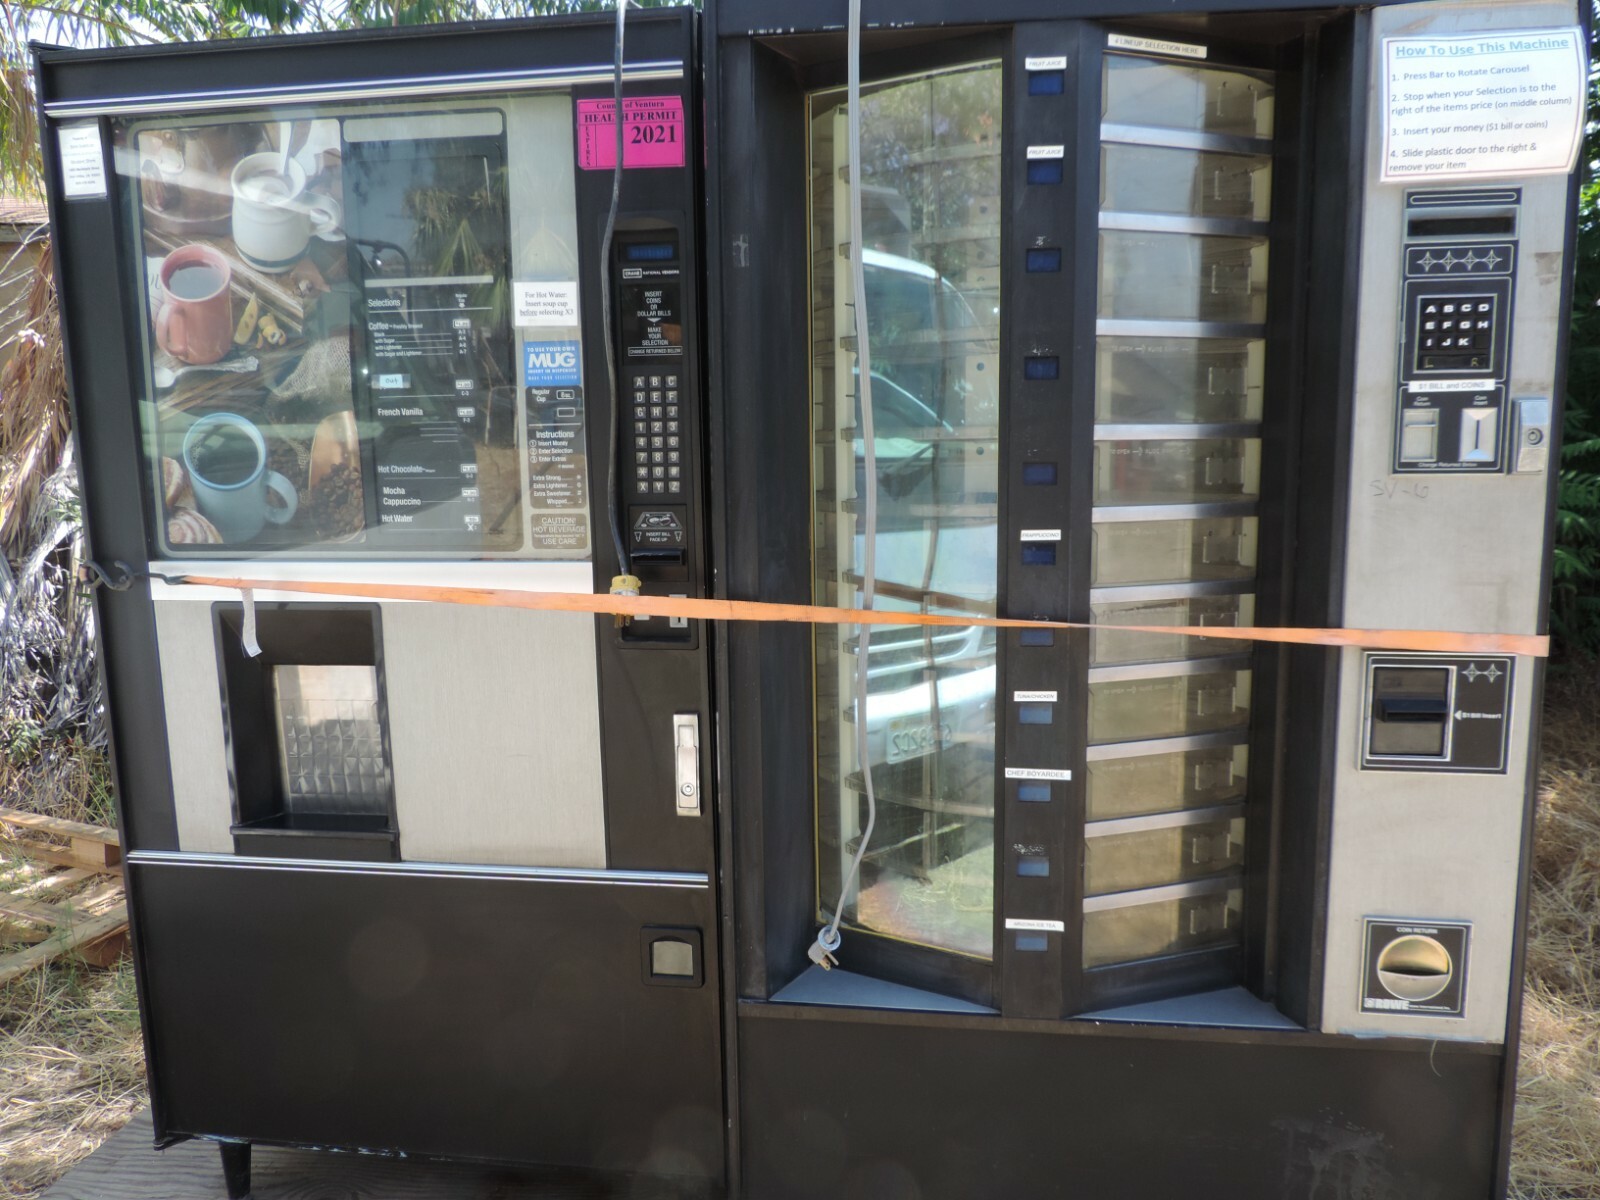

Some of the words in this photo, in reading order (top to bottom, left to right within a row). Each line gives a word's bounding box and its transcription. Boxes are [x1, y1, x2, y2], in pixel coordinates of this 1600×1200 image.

[1145, 41, 1180, 51] SELECTION
[1396, 46, 1426, 56] How
[1430, 46, 1445, 56] To
[1449, 46, 1474, 56] Use
[1478, 42, 1505, 53] This
[1510, 38, 1569, 50] Machine
[1404, 72, 1427, 80] Press
[1490, 65, 1529, 74] Carousel
[1404, 93, 1424, 102] Stop
[1453, 90, 1473, 99] your
[1476, 87, 1517, 95] Selection
[1541, 83, 1556, 91] the
[1392, 107, 1412, 116] right
[1443, 102, 1468, 111] items
[1471, 101, 1492, 111] price
[1495, 101, 1508, 109] (on
[1510, 99, 1537, 107] middle
[1539, 97, 1572, 107] column)
[585, 113, 628, 123] HEALH
[633, 111, 677, 120] PERMIT
[631, 125, 676, 144] 2021
[1404, 126, 1428, 135] Insert
[1431, 126, 1451, 135] your
[1454, 125, 1483, 133] money
[1486, 123, 1498, 132] ($1
[1525, 120, 1548, 130] coins)
[1402, 148, 1423, 157] Slide
[1425, 147, 1453, 157] plastic
[1507, 143, 1527, 152] right
[1390, 163, 1422, 172] remove
[1424, 162, 1444, 171] your
[528, 352, 575, 368] MUG
[383, 498, 421, 506] Cappuccino
